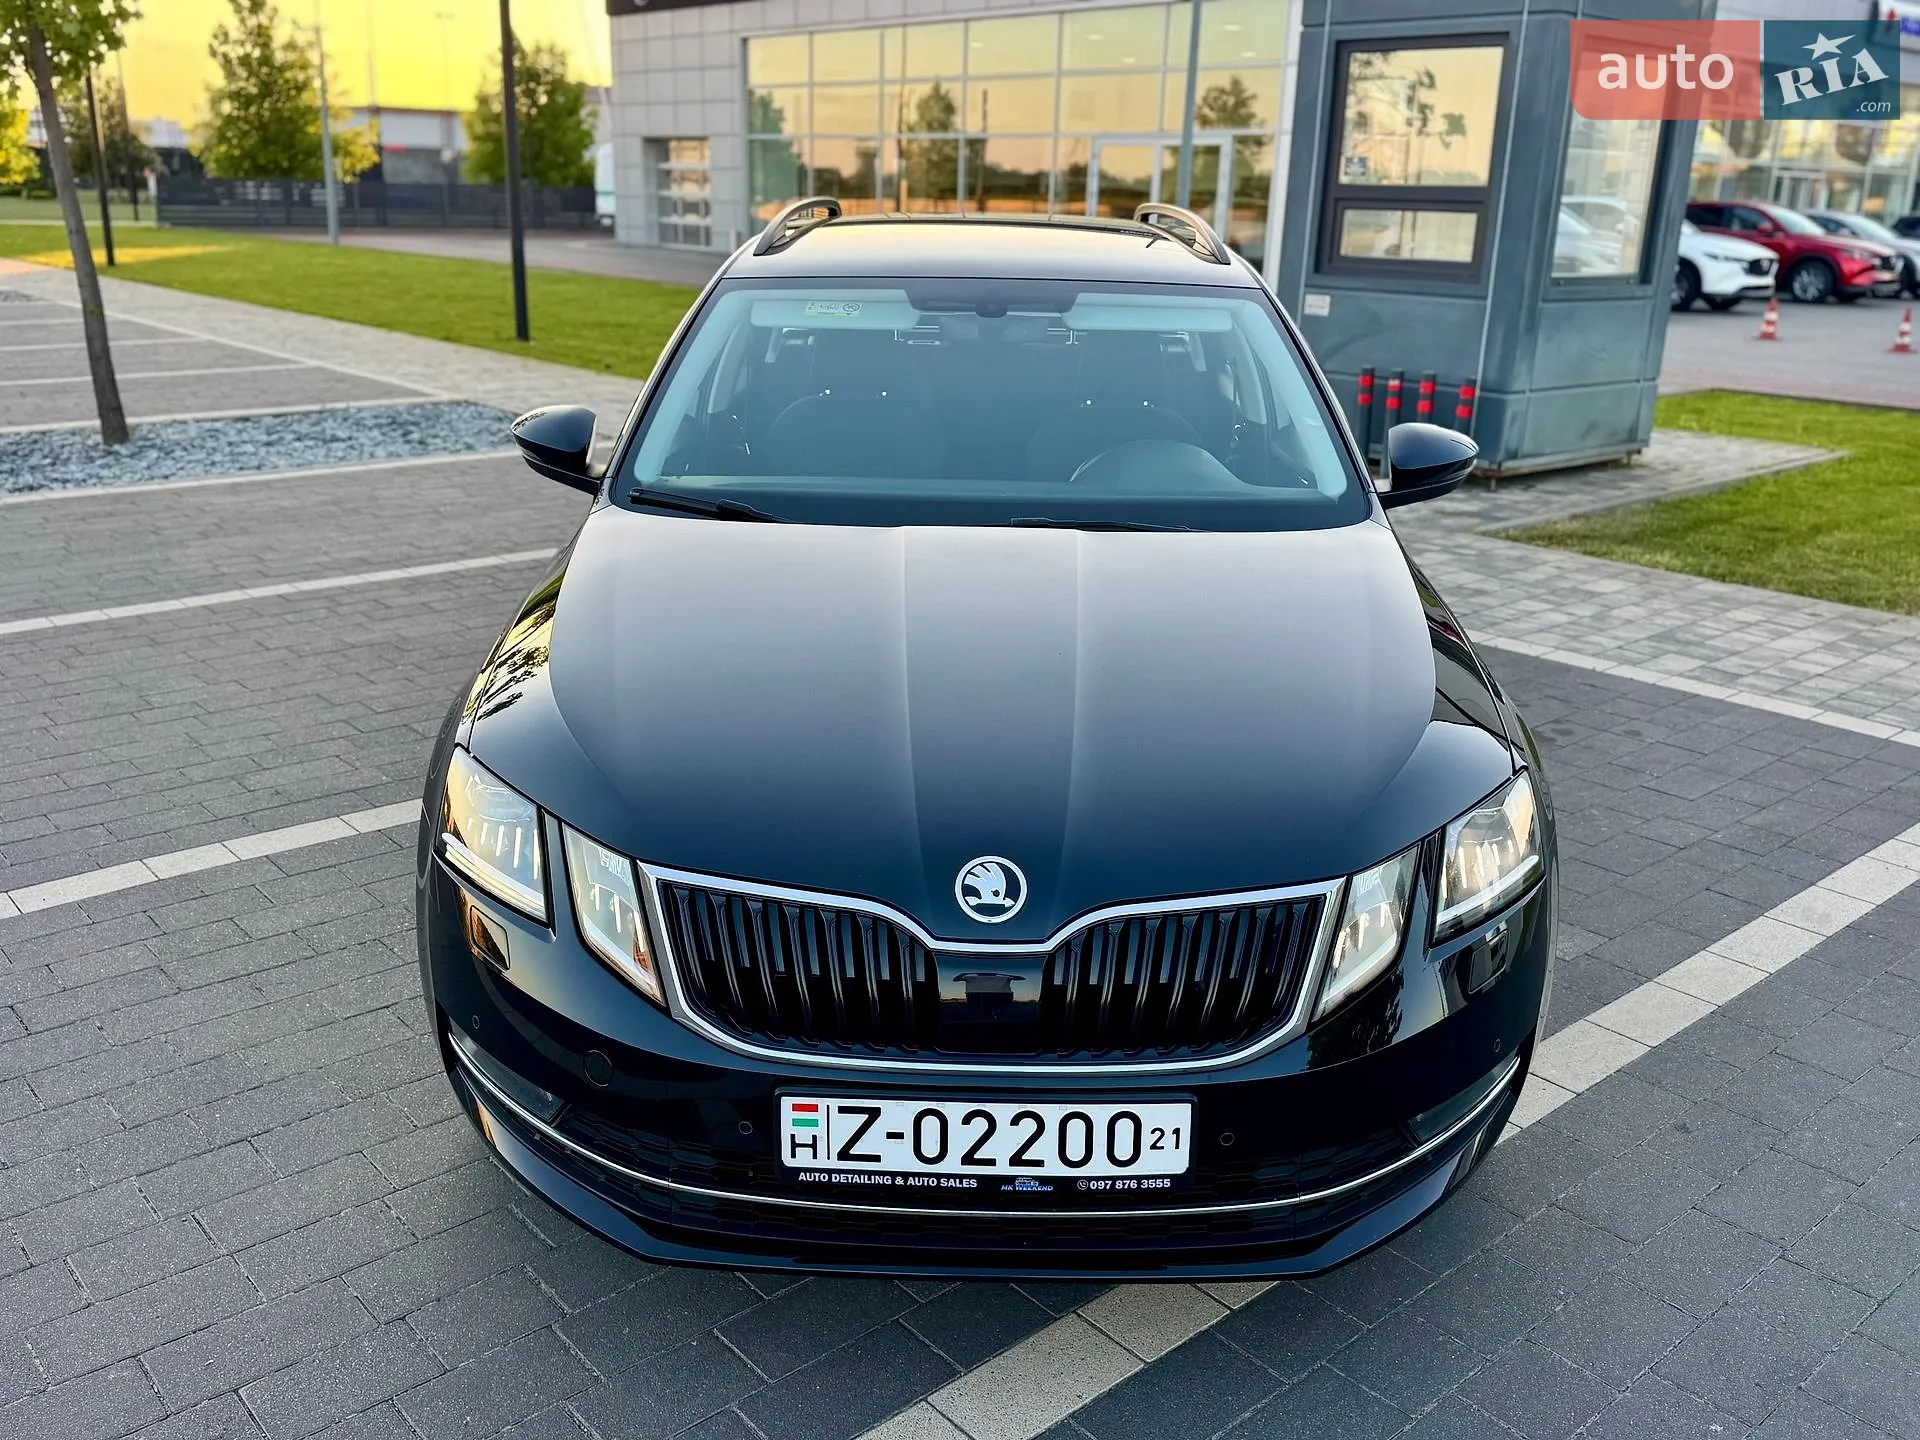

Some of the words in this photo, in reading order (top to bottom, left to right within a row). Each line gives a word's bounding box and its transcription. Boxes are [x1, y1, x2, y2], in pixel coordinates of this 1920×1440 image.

[790, 1133, 818, 1160] H
[836, 1105, 1142, 1169] Z-02200
[1149, 1127, 1181, 1151] 21
[798, 1172, 829, 1182] AUTO
[831, 1173, 892, 1185] DETAILING
[894, 1176, 904, 1185] &
[906, 1176, 938, 1187] AUTO
[939, 1178, 978, 1188] SALES
[1089, 1180, 1113, 1190] 097
[1115, 1179, 1138, 1189] 876
[1140, 1178, 1171, 1189] 3555
